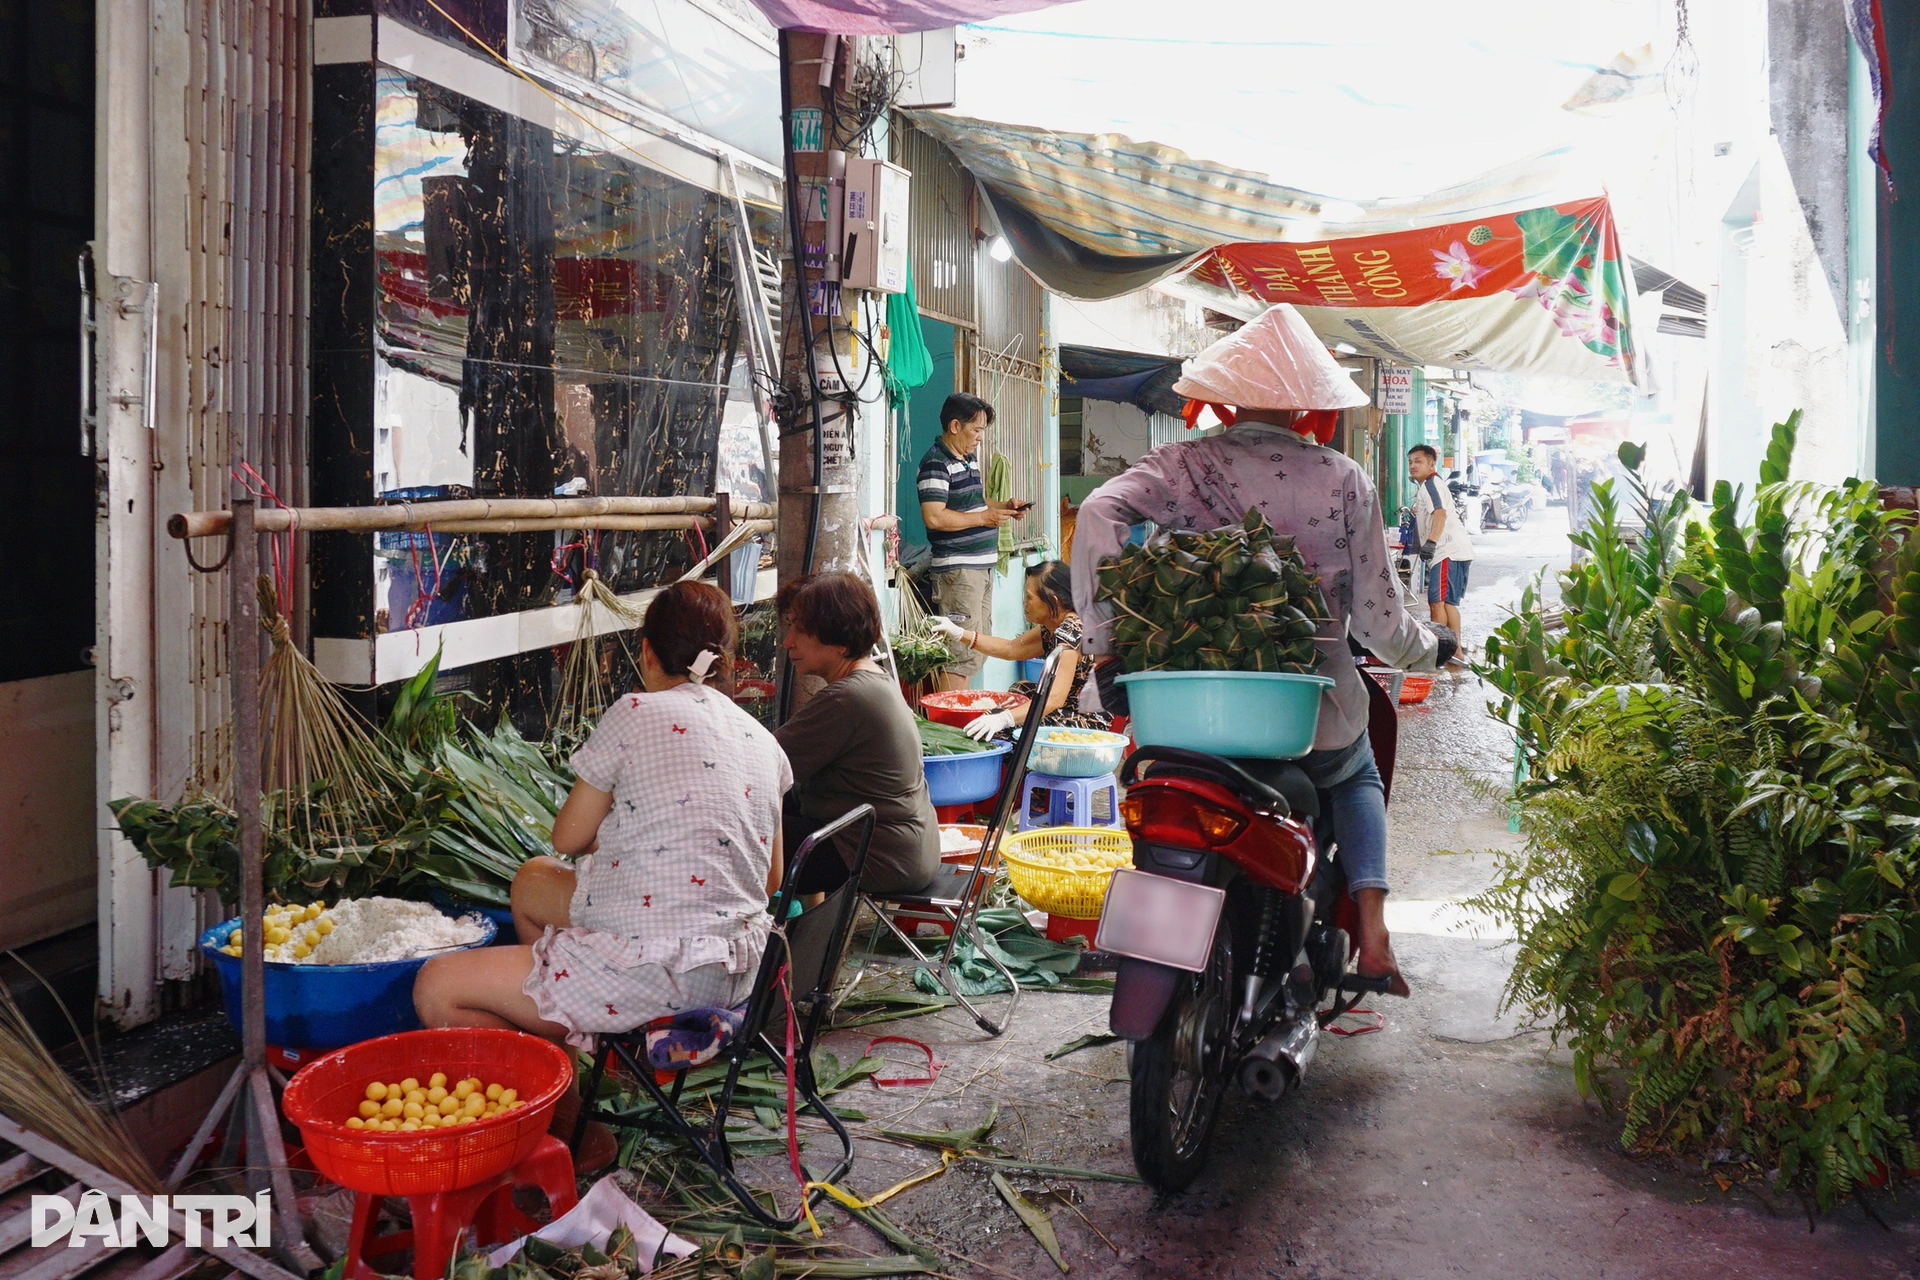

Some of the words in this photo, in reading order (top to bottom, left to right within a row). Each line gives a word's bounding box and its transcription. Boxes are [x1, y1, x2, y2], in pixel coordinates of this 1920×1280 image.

[1252, 266, 1300, 292] ĐẠI
[1295, 244, 1358, 302] THÀNH
[1353, 249, 1408, 298] CÔNG
[1382, 376, 1408, 385] HOA
